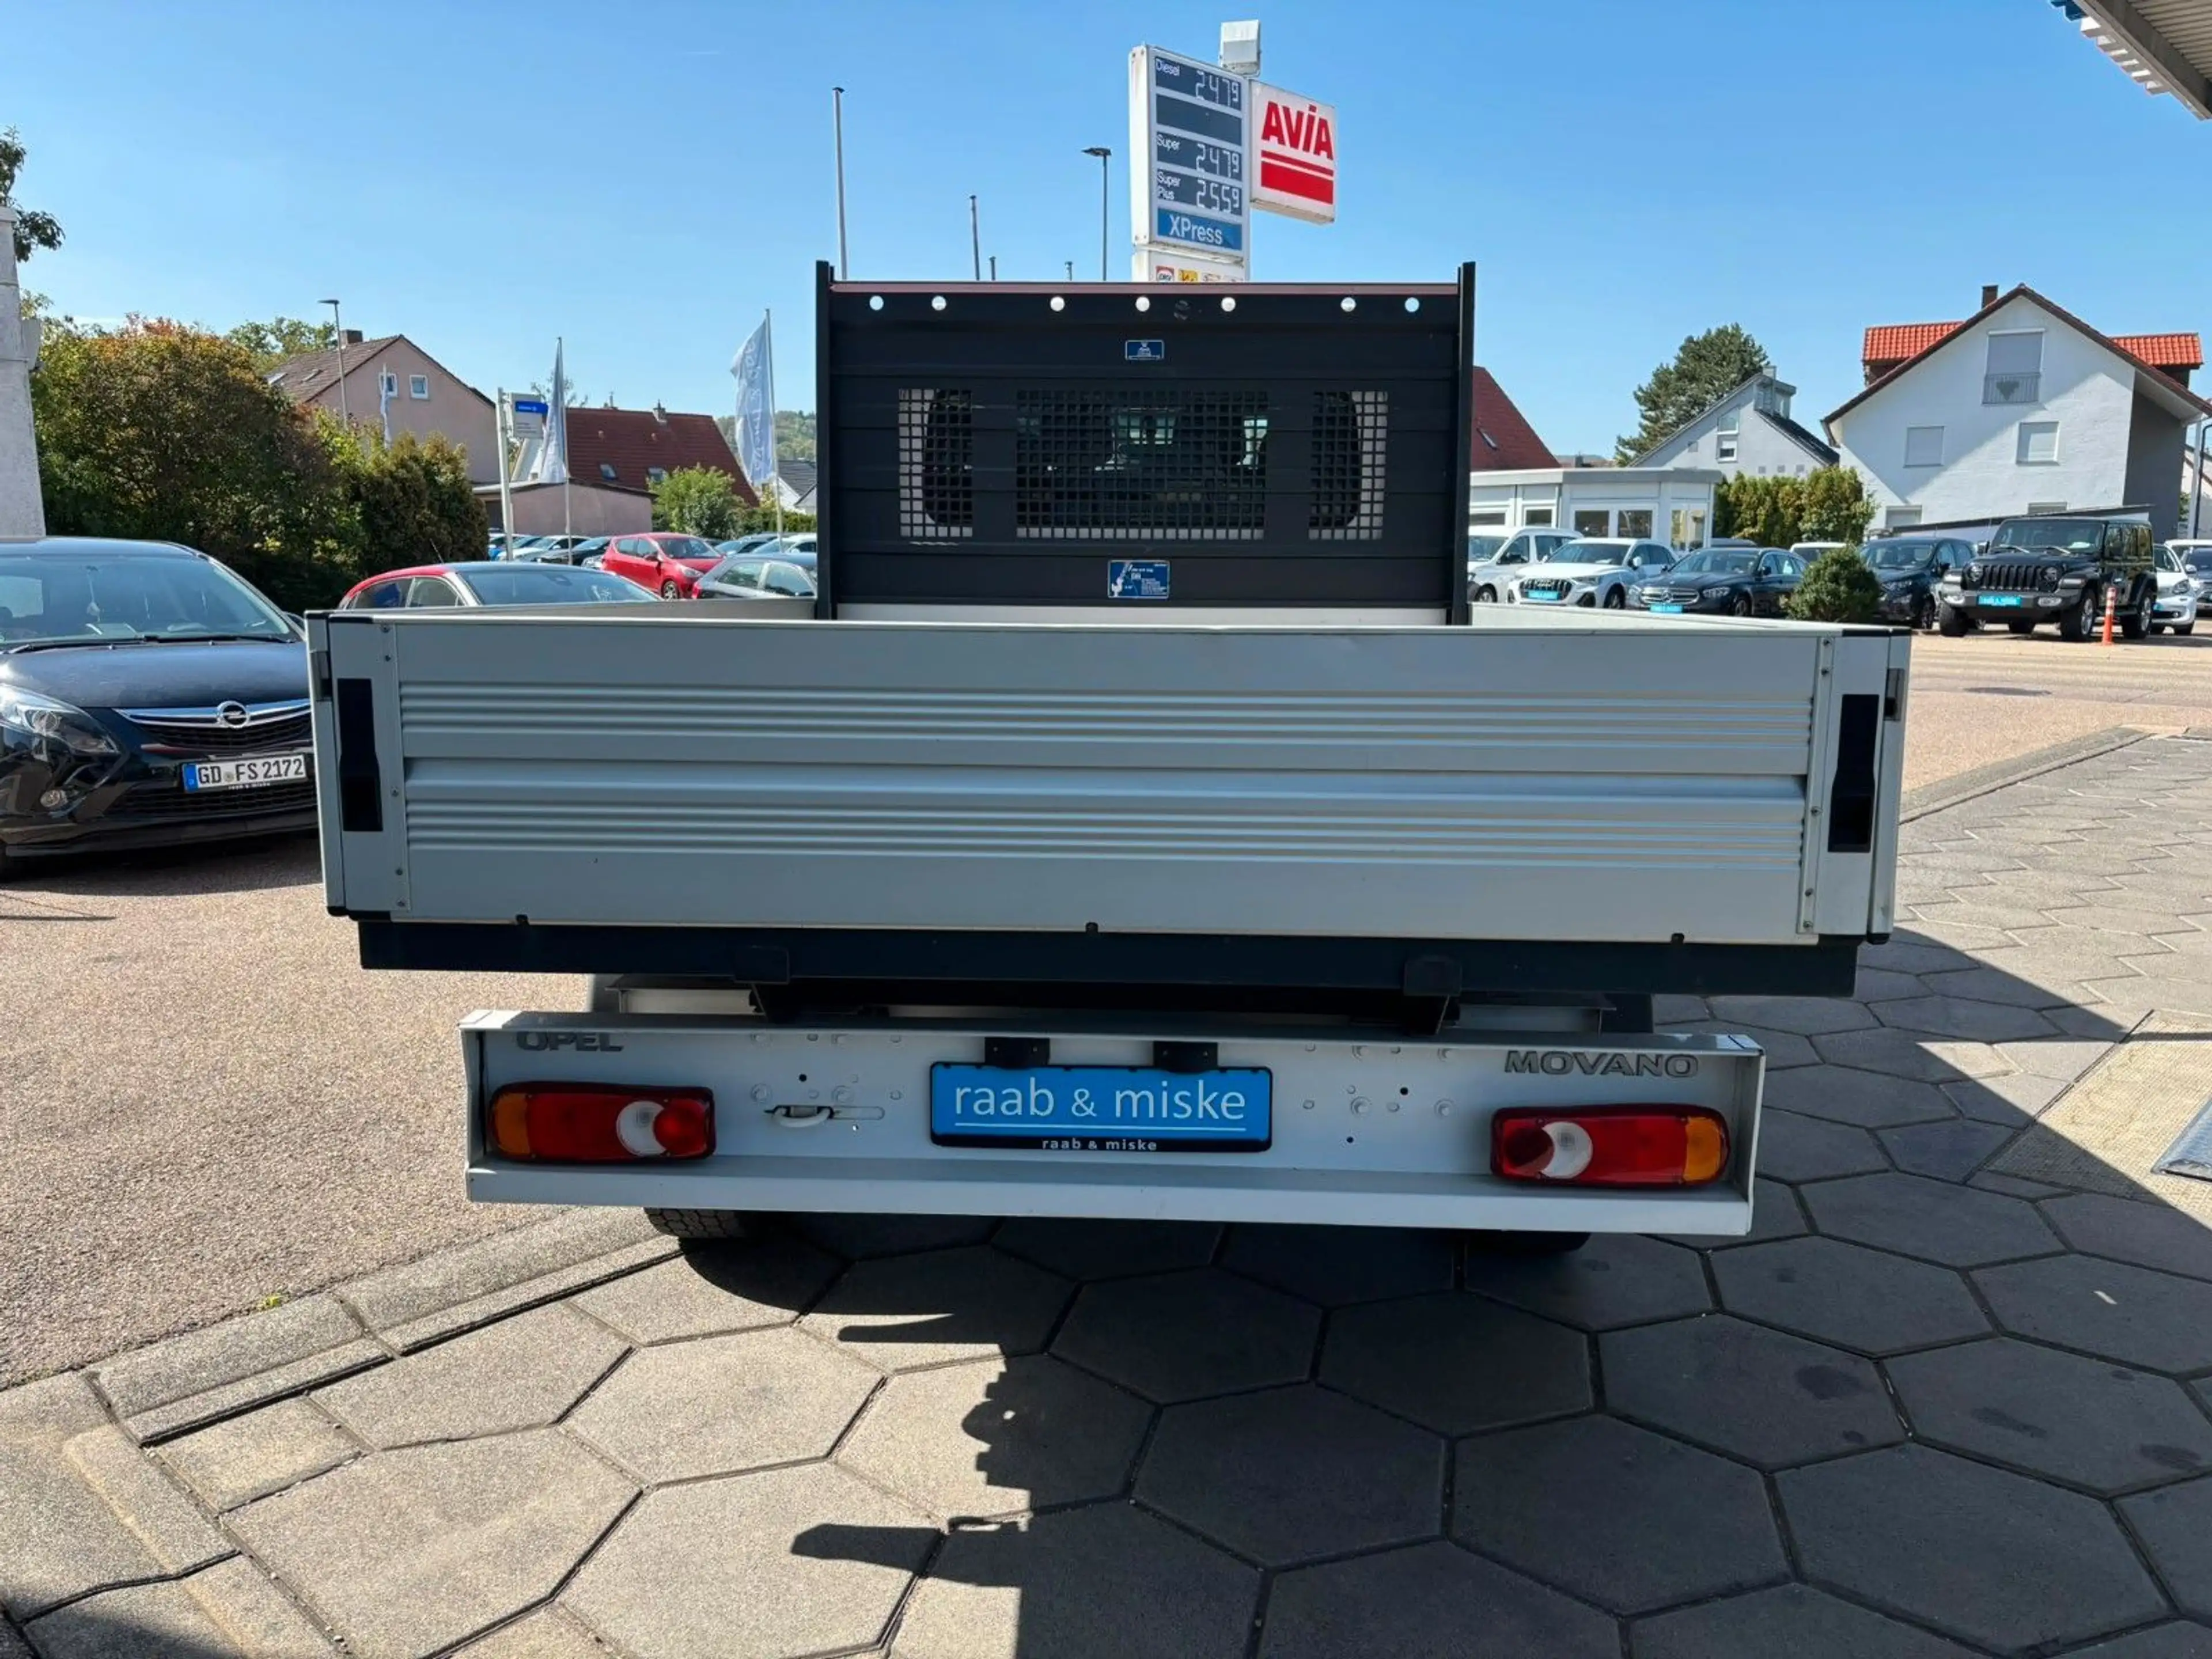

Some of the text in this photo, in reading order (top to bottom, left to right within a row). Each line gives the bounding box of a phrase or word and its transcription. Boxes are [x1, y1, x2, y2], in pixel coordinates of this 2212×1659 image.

[1156, 58, 1180, 77] Diesel
[1156, 134, 1180, 151] Super
[1156, 171, 1181, 188] Super
[1156, 185, 1175, 200] Plus
[1169, 214, 1224, 245] XPress
[198, 758, 304, 784] GD FS 2172
[516, 1031, 624, 1052] OPEL
[1504, 1050, 1699, 1078] MOVANO
[955, 1077, 1246, 1120] raab & miske
[1042, 1137, 1157, 1152] raab & miske
